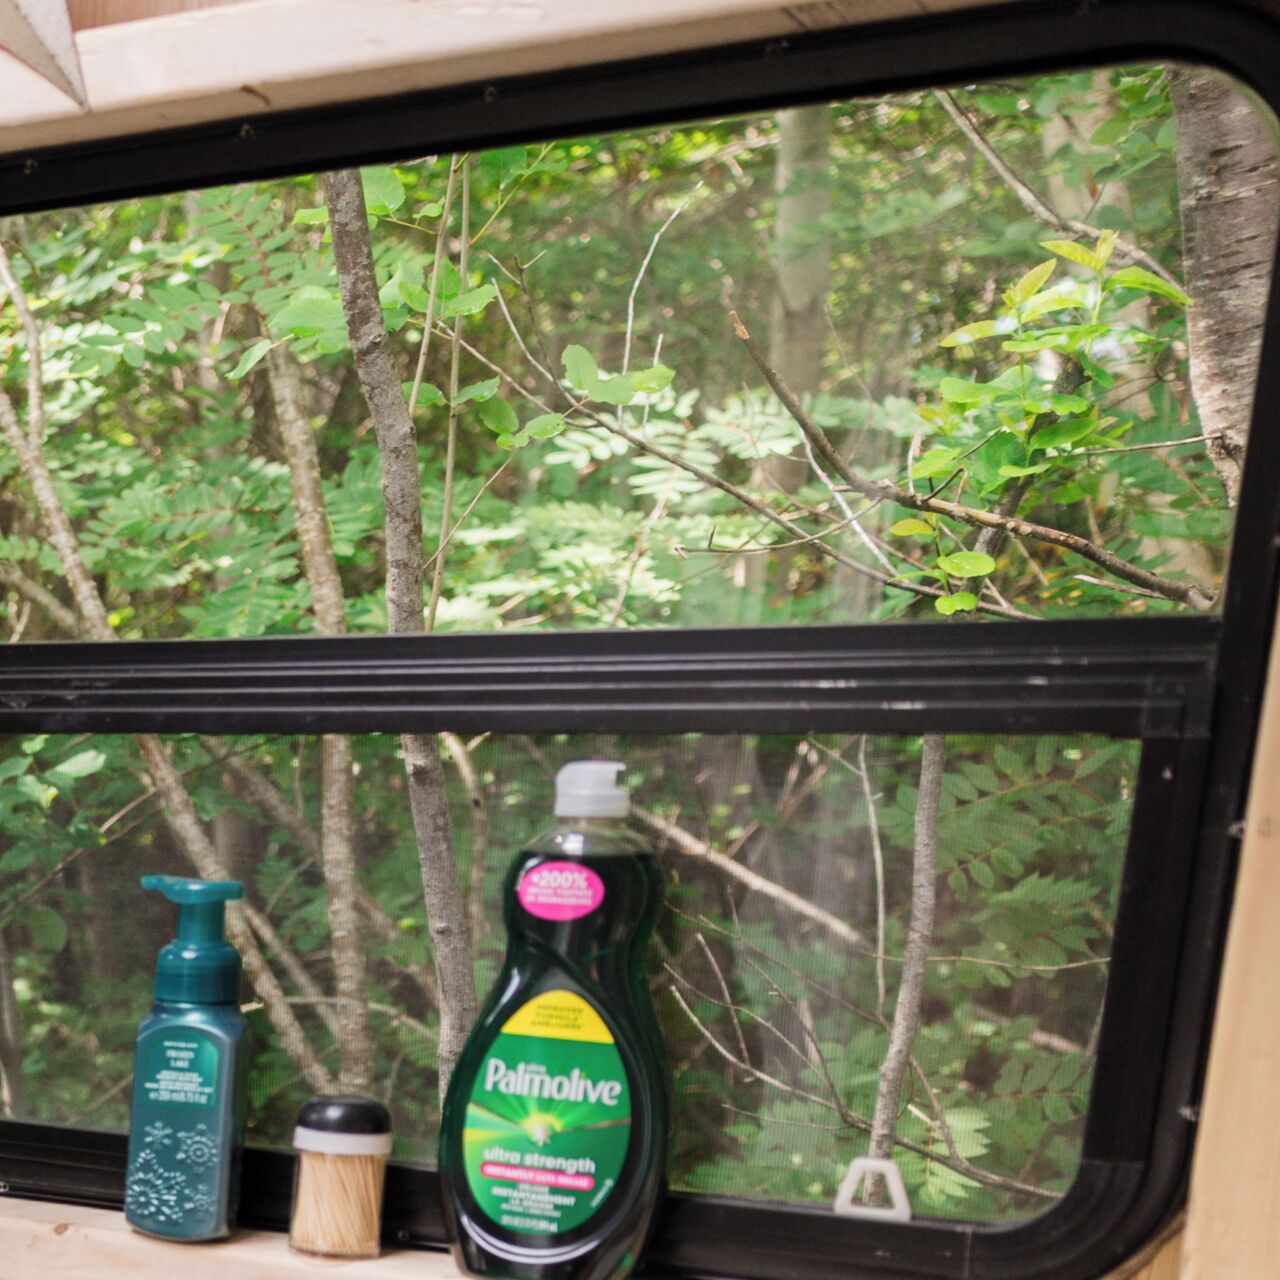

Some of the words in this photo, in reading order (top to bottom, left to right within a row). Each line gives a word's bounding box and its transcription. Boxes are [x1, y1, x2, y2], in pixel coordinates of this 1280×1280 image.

[531, 869, 588, 889] +200%
[484, 1057, 622, 1106] Palmolive
[482, 1146, 521, 1164] ultra
[523, 1151, 596, 1175] strength
